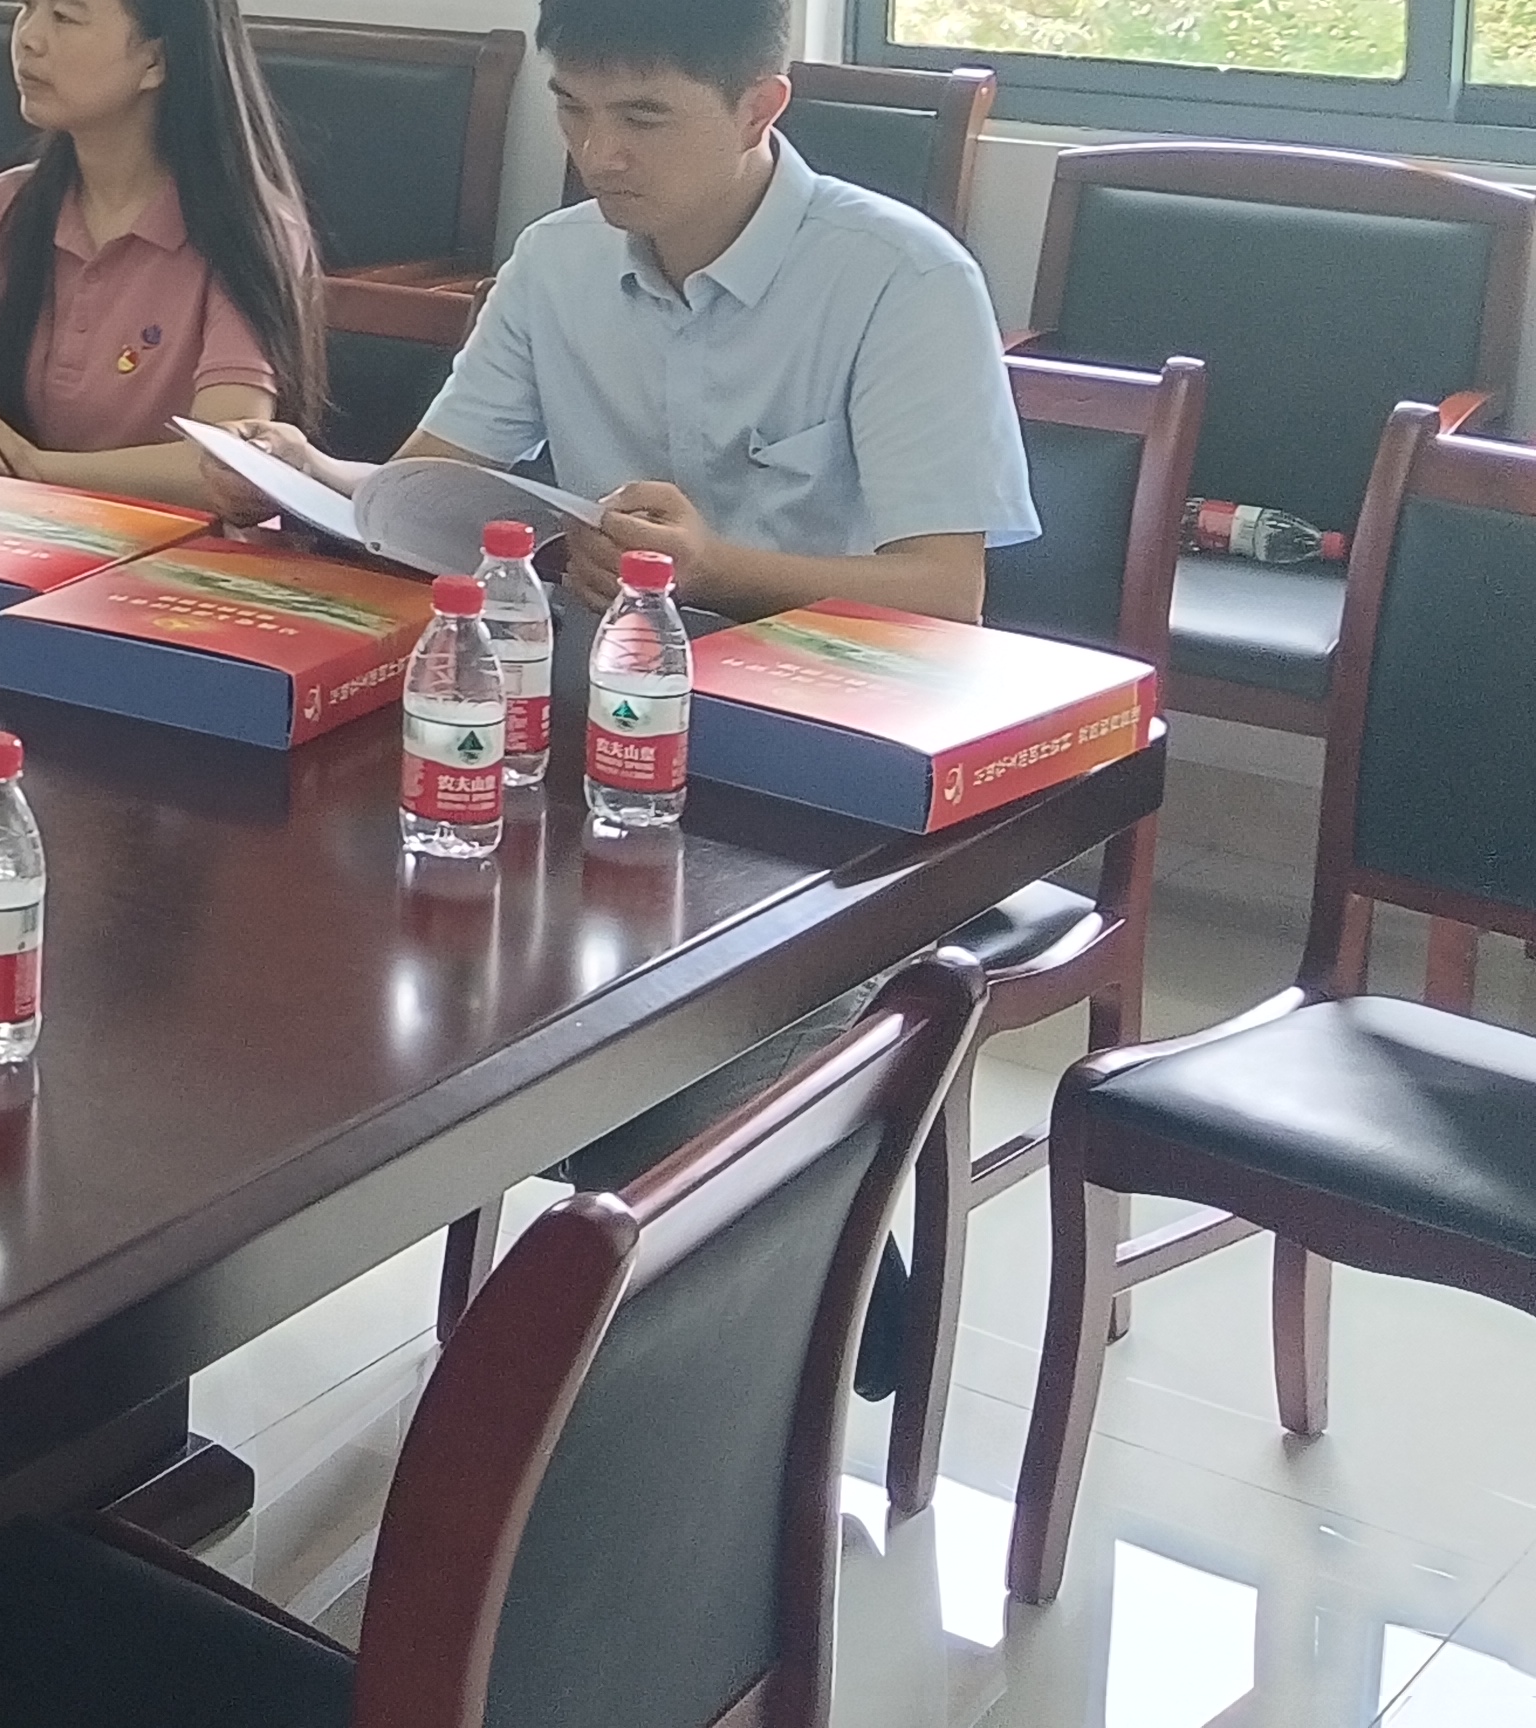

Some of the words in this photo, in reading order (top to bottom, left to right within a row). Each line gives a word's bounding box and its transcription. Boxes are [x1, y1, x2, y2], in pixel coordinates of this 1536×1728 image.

[595, 737, 657, 761] 农夫山泉
[436, 774, 496, 793] 农夫山泉
